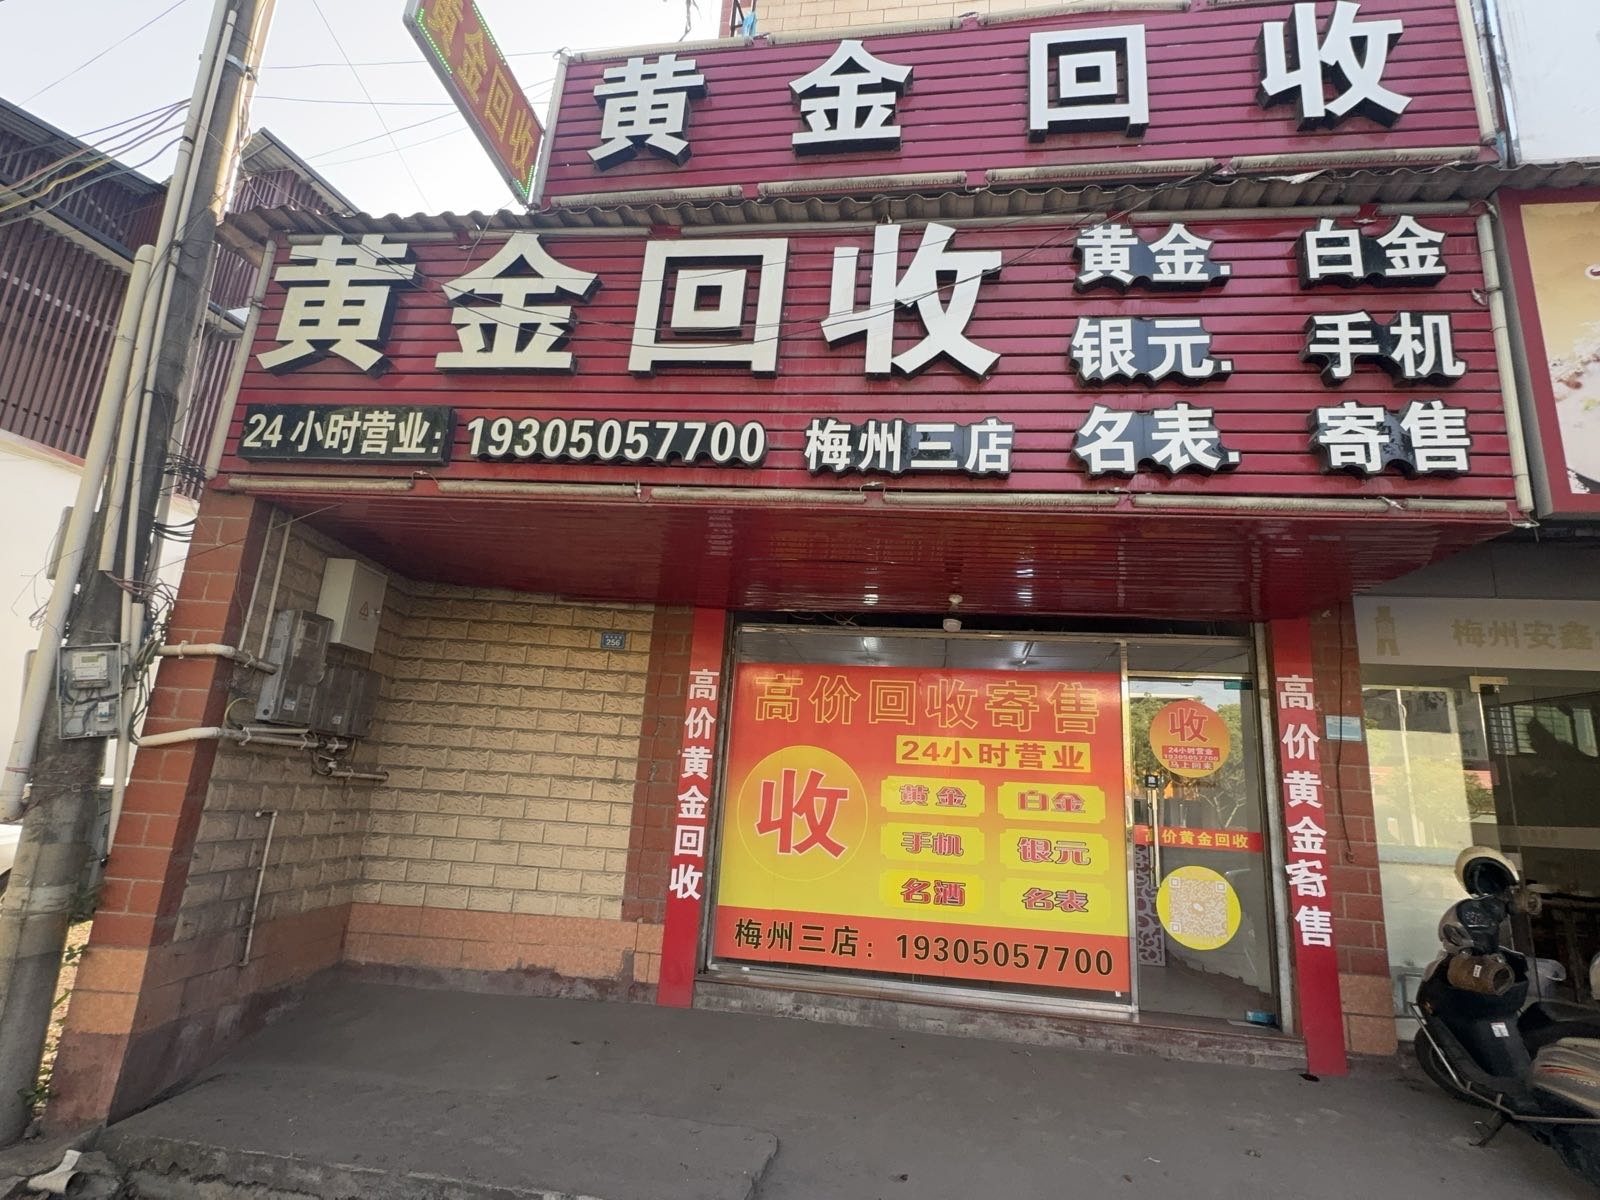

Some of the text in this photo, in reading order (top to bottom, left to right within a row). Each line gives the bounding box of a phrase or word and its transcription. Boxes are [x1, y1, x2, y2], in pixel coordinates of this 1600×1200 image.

[588, 1, 1412, 162] 黄金回收
[1305, 215, 1447, 279] 白金
[256, 223, 1002, 379] 黄金回收
[1308, 311, 1467, 379] 手机
[466, 416, 766, 464] 19305057700
[805, 418, 1014, 472] 梅州三店
[1317, 401, 1472, 473] 寄售
[1452, 619, 1600, 650] 梅州安鑫
[754, 674, 1101, 735] 高价回收寄售
[1167, 707, 1209, 743] 收
[901, 740, 1085, 771] 24小时营业
[669, 669, 720, 900] 高价黄金回收
[899, 783, 1086, 814] 黄金 白金
[754, 767, 849, 859] 收
[901, 830, 1091, 867] 手机 银元
[900, 878, 1089, 914] 名酒 名表
[895, 933, 1114, 977] 19305057700
